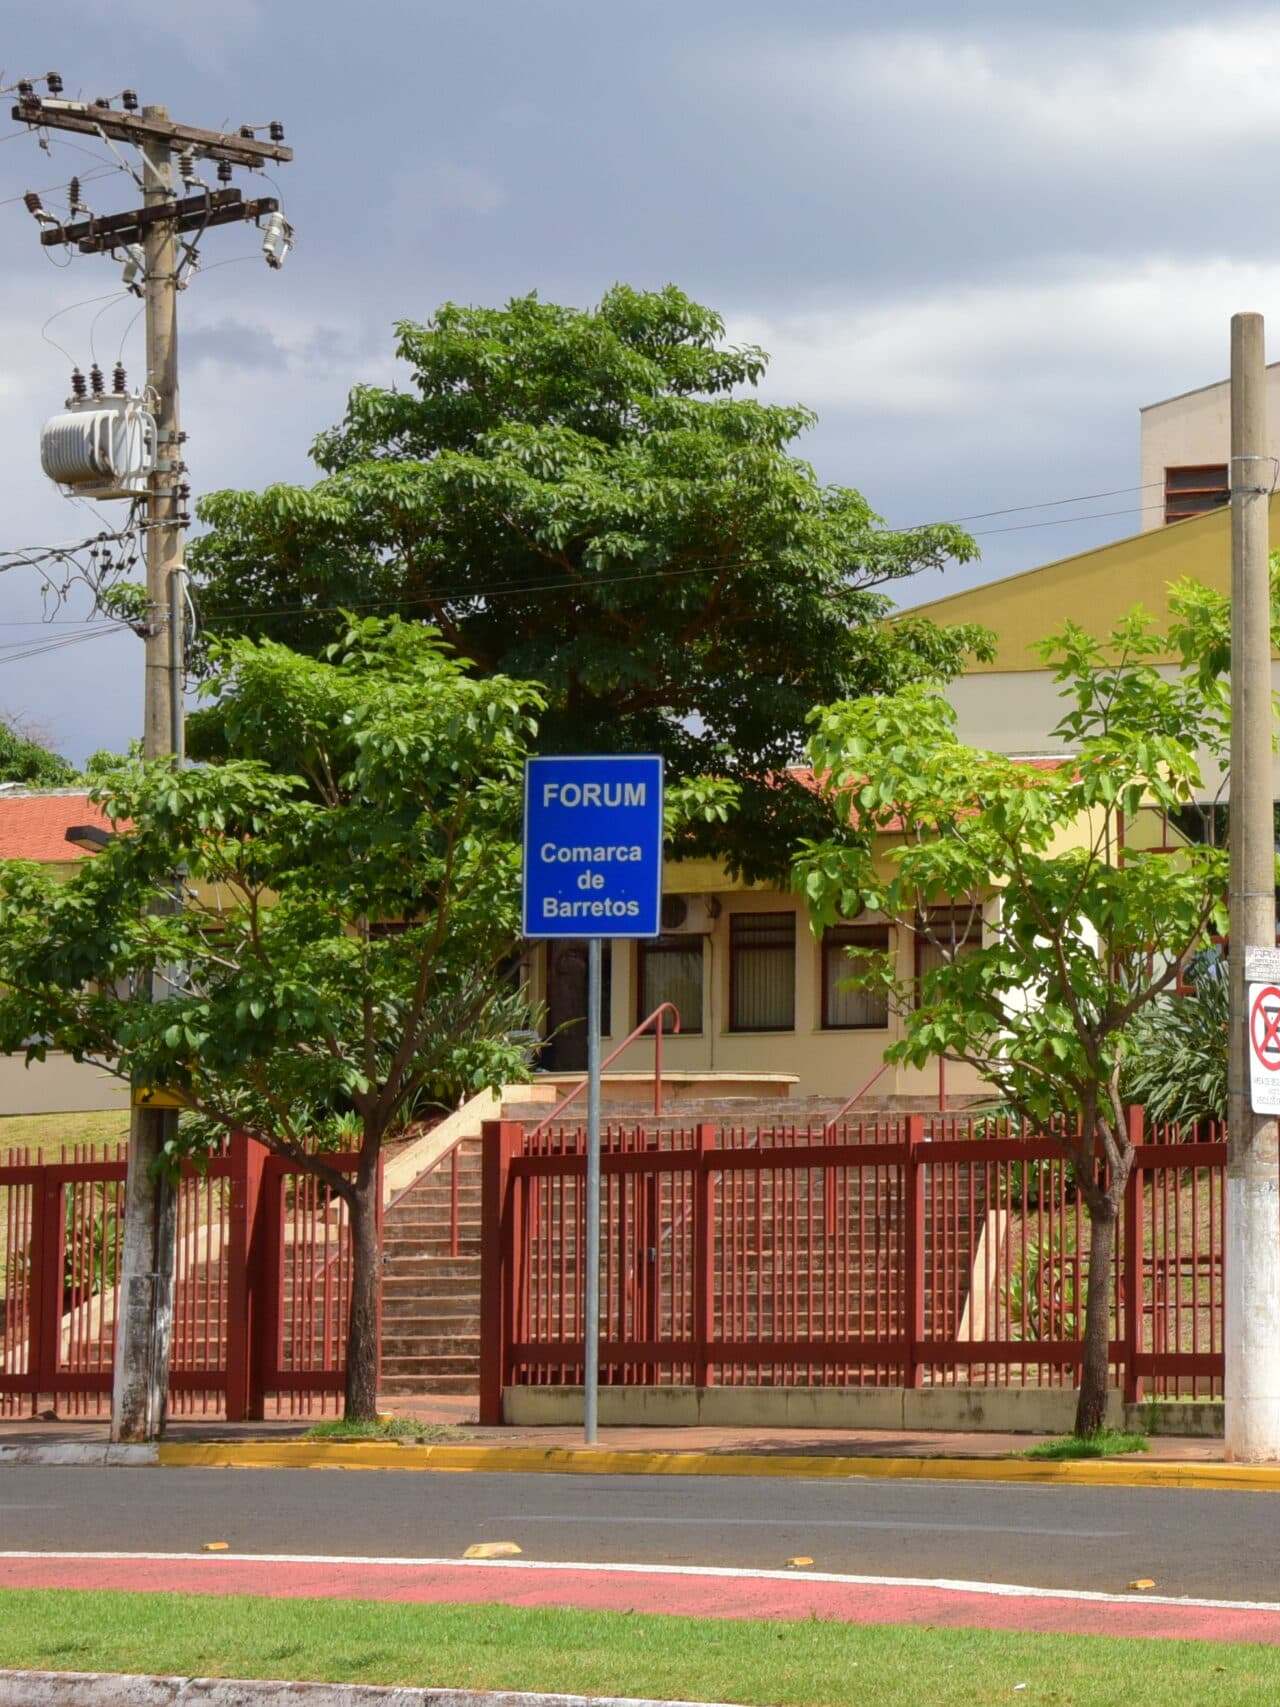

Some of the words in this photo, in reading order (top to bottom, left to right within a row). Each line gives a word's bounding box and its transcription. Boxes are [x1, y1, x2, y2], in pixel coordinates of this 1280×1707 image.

[543, 783, 646, 808] FORUM
[540, 842, 642, 863] Comarca
[577, 869, 605, 890] de
[543, 897, 640, 918] Barretos
